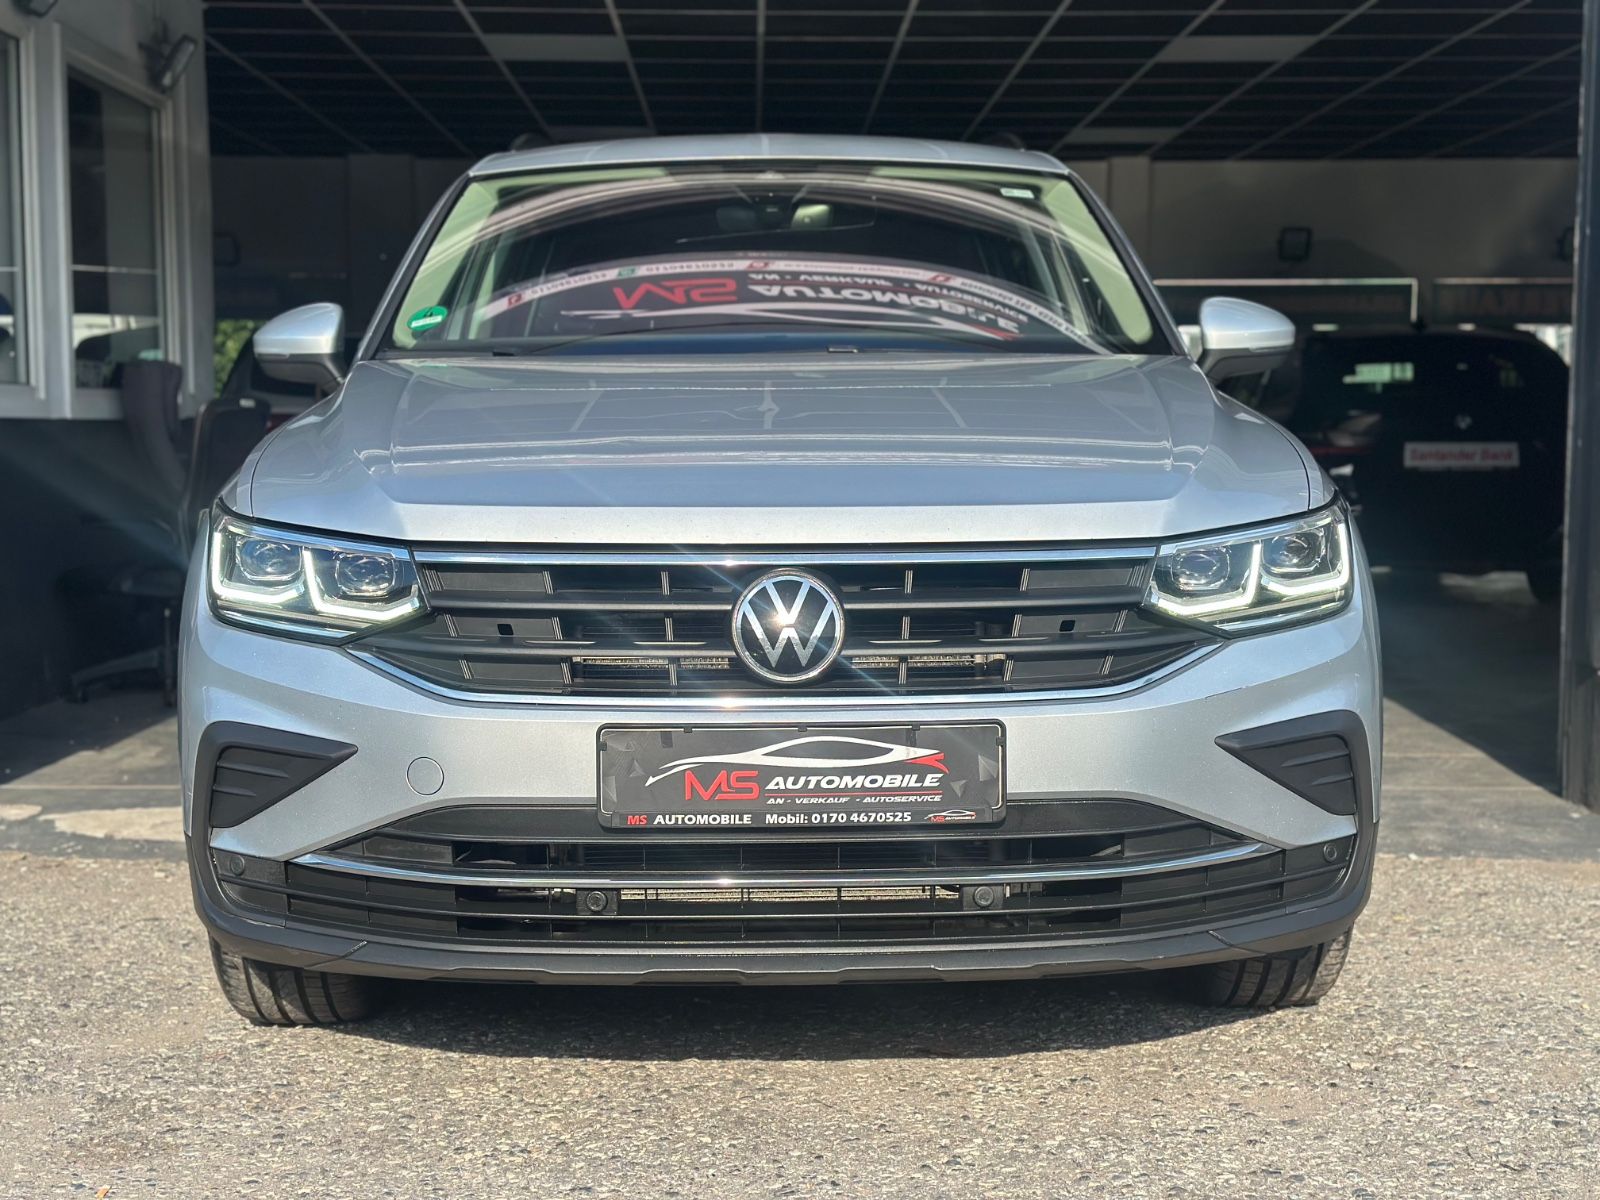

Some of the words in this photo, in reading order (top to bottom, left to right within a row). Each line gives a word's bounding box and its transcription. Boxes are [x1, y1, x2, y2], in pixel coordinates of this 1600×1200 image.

[685, 770, 760, 800] MS
[765, 774, 944, 790] AUTOMOBILE
[766, 797, 786, 805] AN
[863, 795, 943, 803] AUTOSERVICE
[627, 815, 647, 825] MS
[653, 814, 752, 825] AUTOMOBILE
[765, 814, 809, 825] Mobil:
[811, 813, 847, 824] 0170
[850, 812, 912, 823] 4670525
